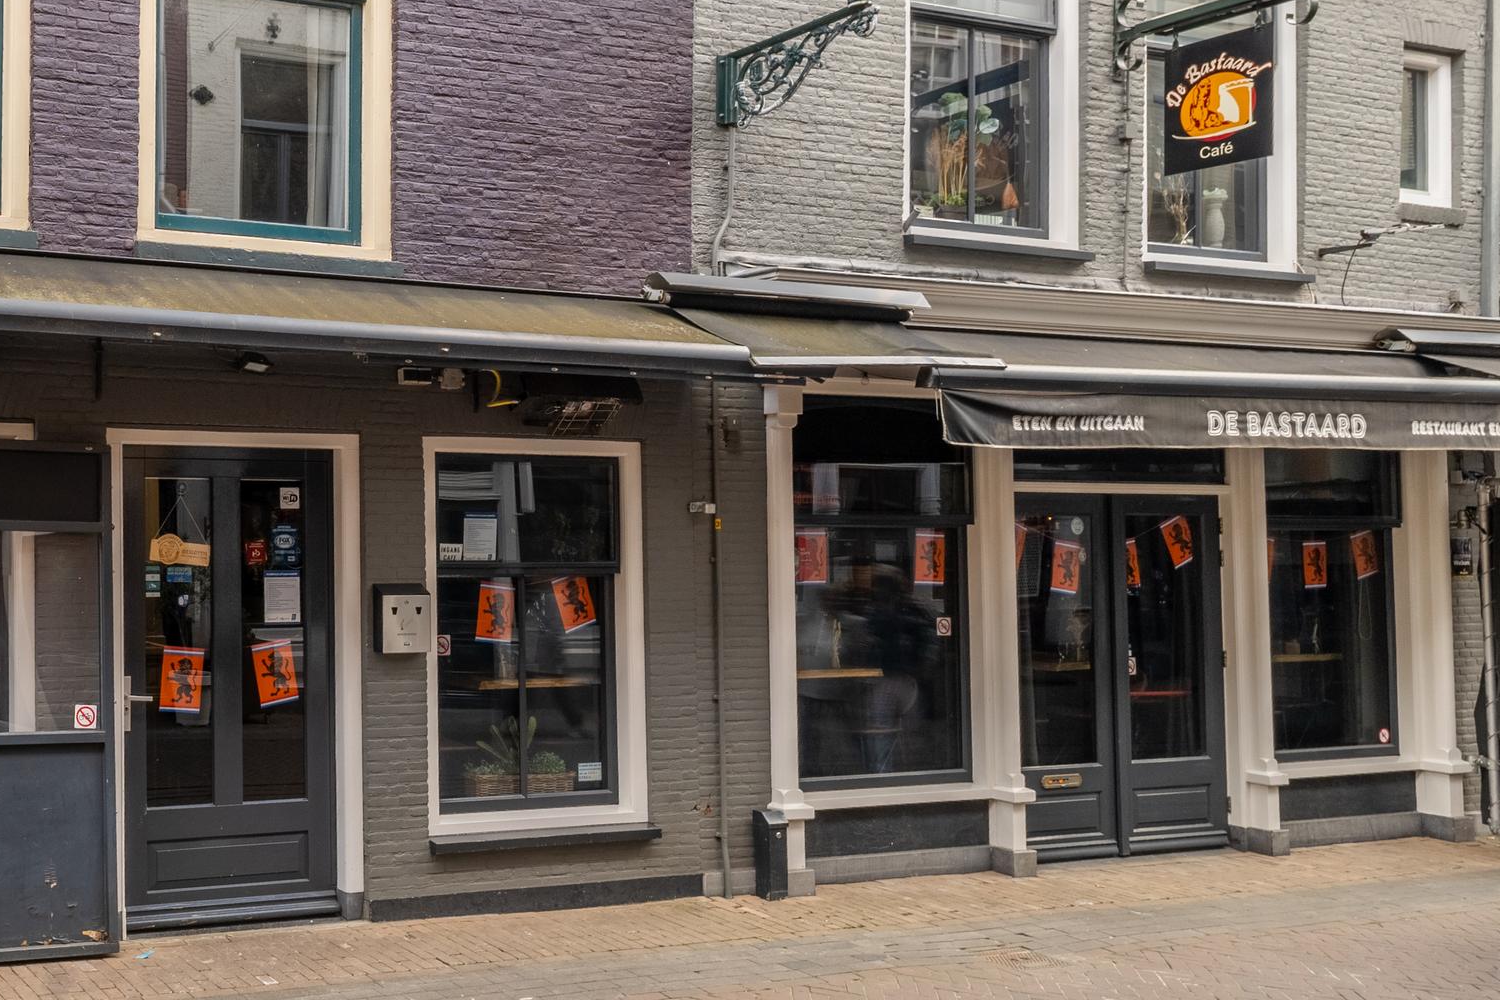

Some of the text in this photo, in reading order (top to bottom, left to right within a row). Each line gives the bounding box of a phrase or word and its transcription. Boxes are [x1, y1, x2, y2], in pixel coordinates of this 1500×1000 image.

[1166, 52, 1272, 107] De Bastaard
[1200, 141, 1233, 158] Café
[1012, 415, 1145, 431] ETEN EN UITGAAN
[1207, 410, 1367, 438] DE BASTAARD
[1411, 420, 1486, 435] RESTAURANT
